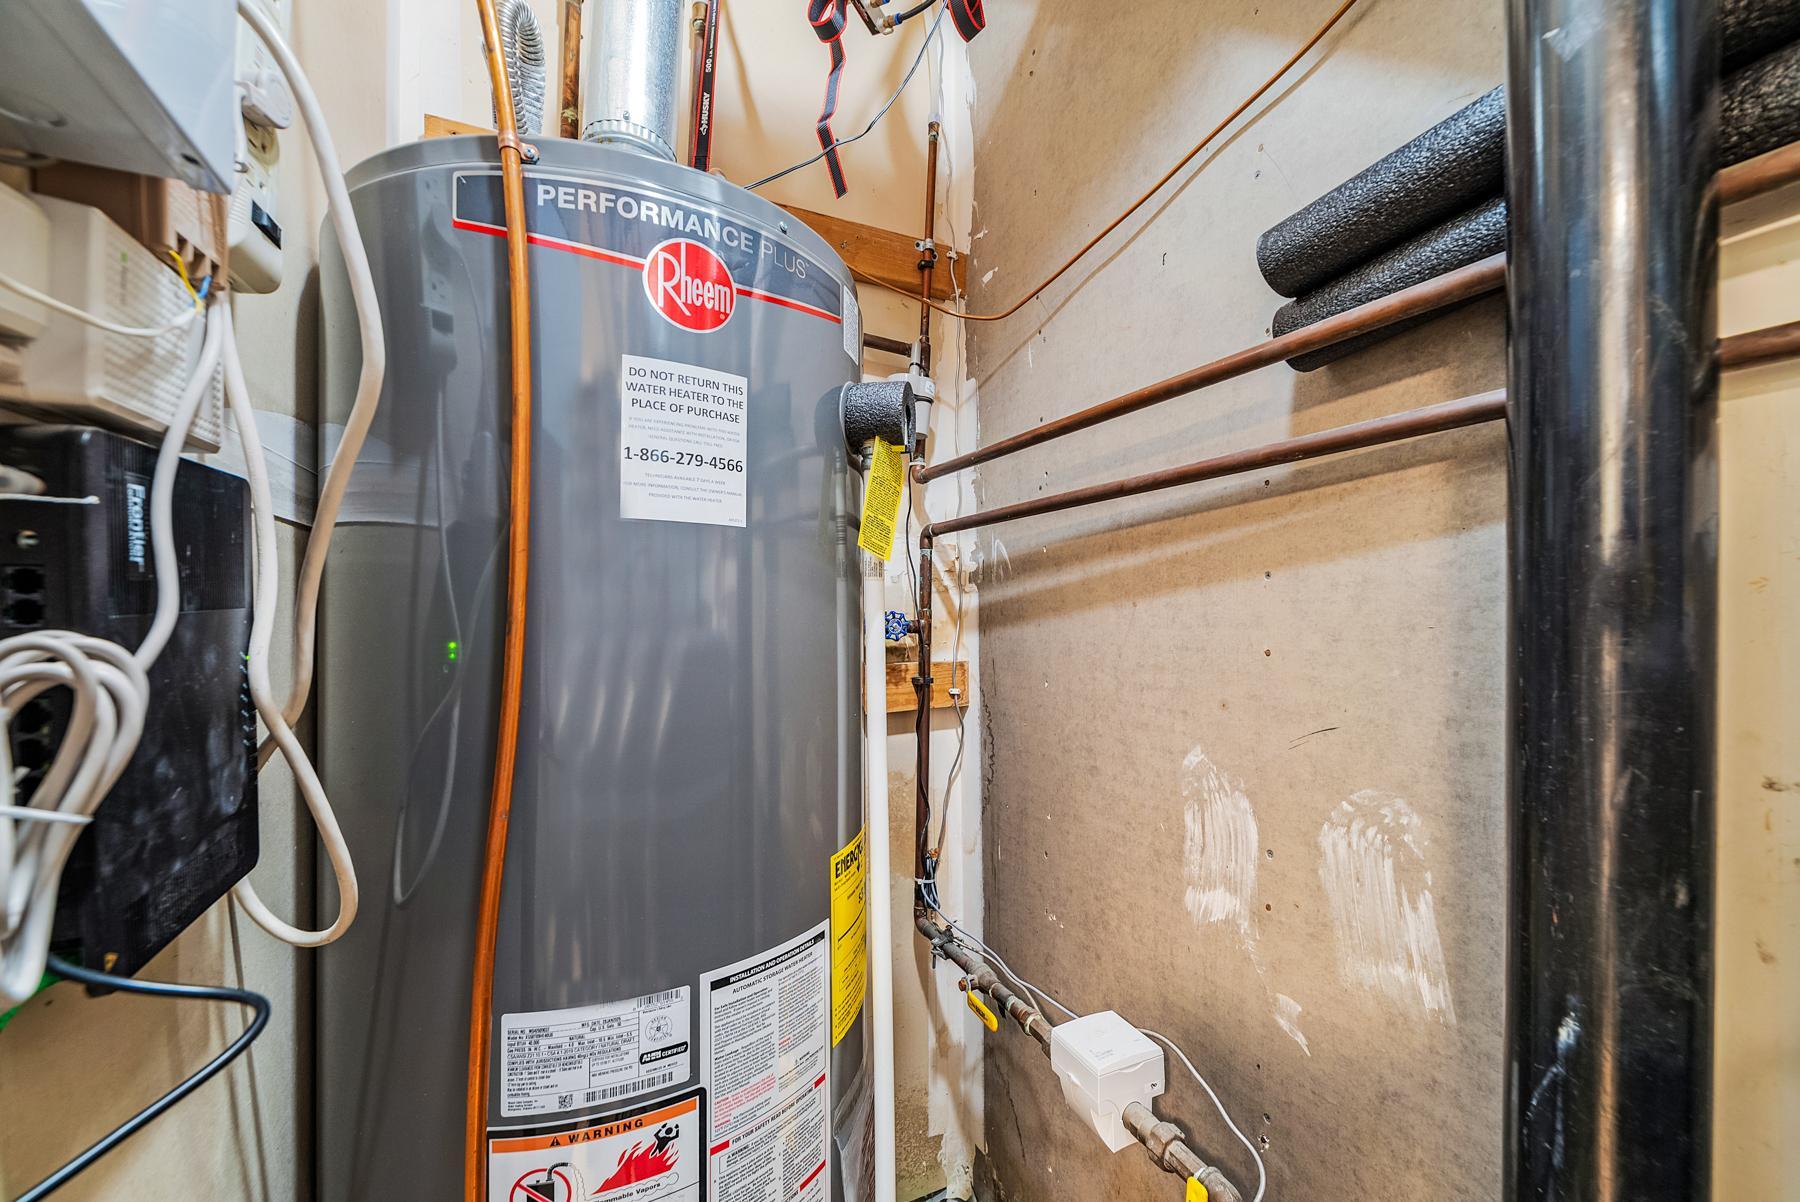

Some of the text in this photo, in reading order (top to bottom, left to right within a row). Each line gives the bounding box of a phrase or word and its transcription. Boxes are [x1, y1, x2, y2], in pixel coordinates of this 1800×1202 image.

[705, 58, 713, 73] 500
[701, 92, 711, 125] HUSKY
[537, 184, 806, 280] PERFORMANCE PLUS
[657, 241, 731, 317] Rheem
[629, 366, 744, 396] DO NOT RETURN THIS
[625, 381, 744, 410] WATER HEATER TO THE
[631, 398, 740, 424] PLACE OF PURCHASE
[624, 446, 743, 473] 1-866-279-4566
[732, 978, 763, 994] AUTOMATIC
[763, 968, 784, 983] STORAGE
[568, 1119, 644, 1145] WARNING
[731, 1135, 742, 1145] FOR
[742, 1129, 755, 1139] YOUR
[754, 1119, 770, 1133] SAFETY
[636, 1182, 661, 1195] Vapors
